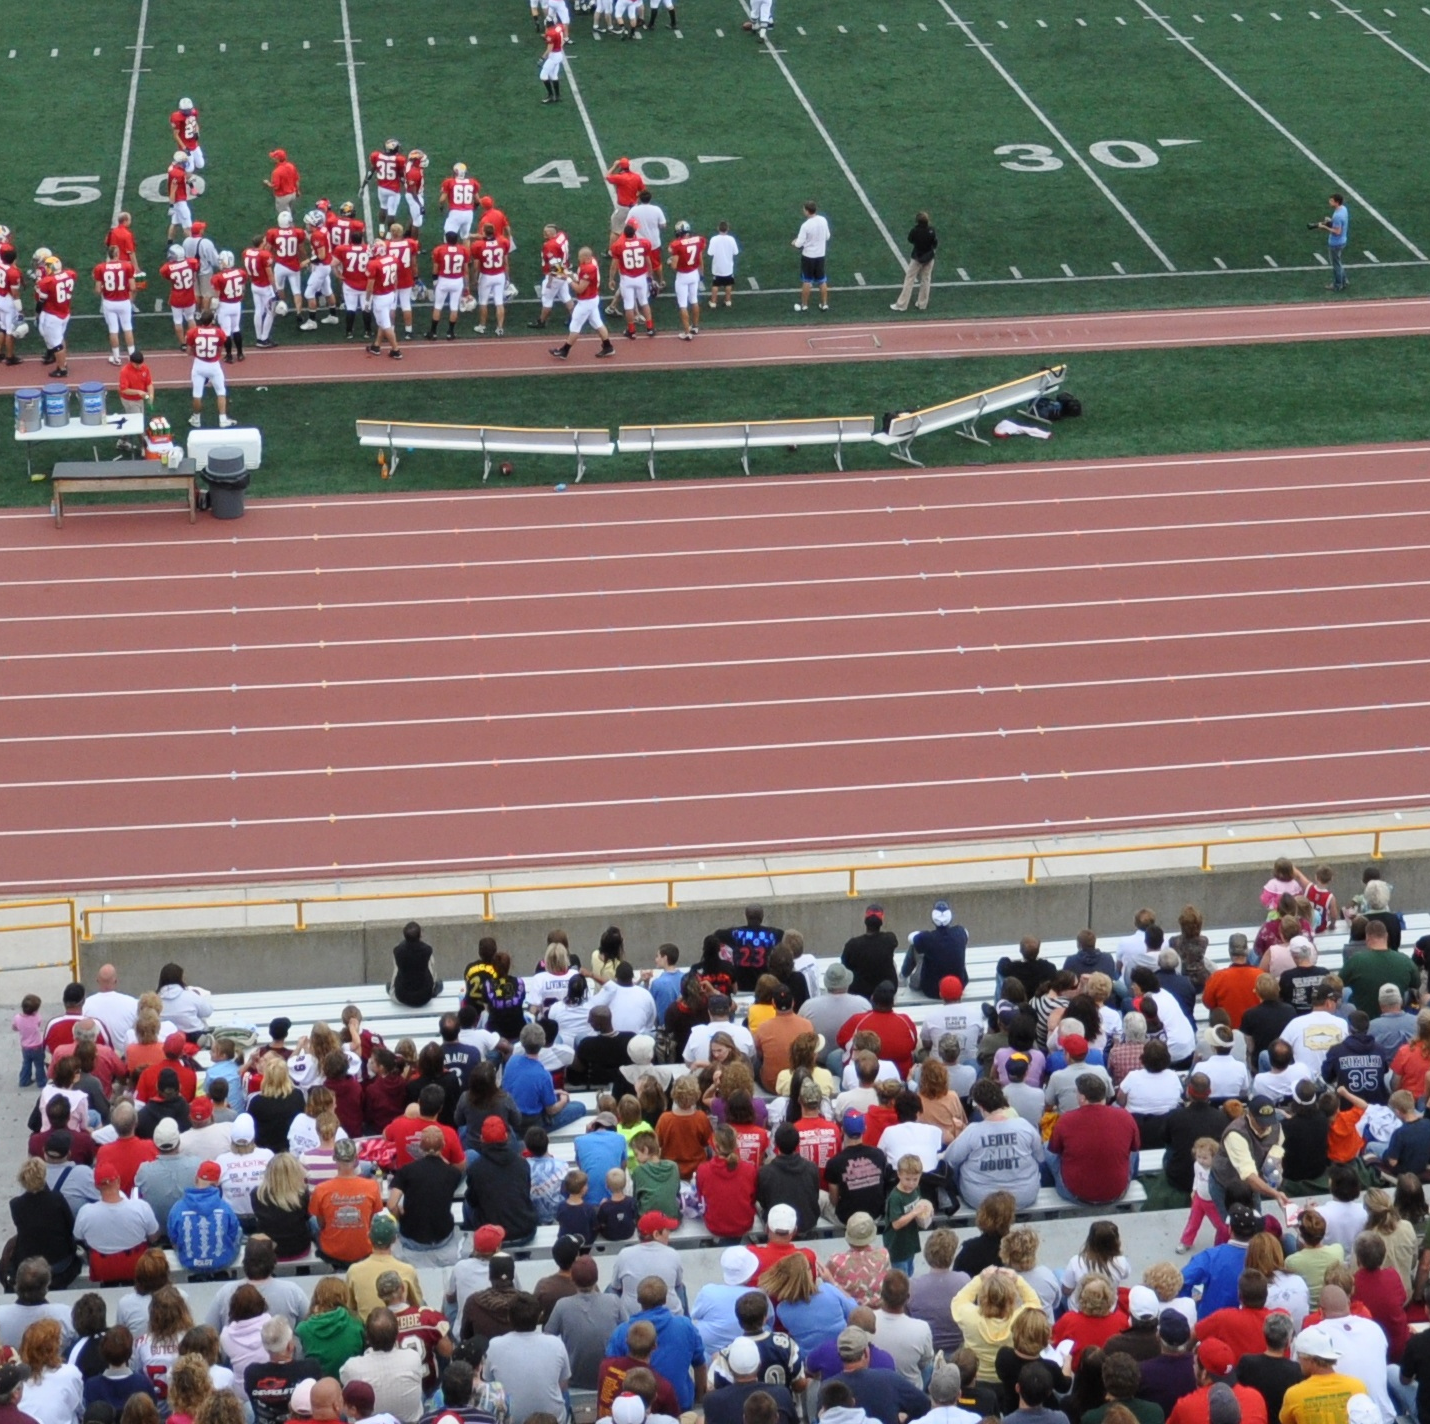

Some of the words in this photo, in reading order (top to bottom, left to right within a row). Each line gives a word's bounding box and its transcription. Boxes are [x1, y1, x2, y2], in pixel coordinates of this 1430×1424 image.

[993, 139, 1160, 172] 30
[376, 161, 397, 181] 35
[522, 155, 691, 189] 40
[33, 172, 206, 206] 50
[452, 184, 474, 205] 66
[275, 237, 298, 257] 30
[331, 226, 351, 246] 61
[345, 252, 368, 273] 78
[443, 255, 464, 275] 12
[482, 248, 504, 269] 33
[622, 247, 645, 270] 65
[686, 244, 698, 266] 7
[243, 257, 258, 276] 11
[382, 264, 398, 287] 72
[103, 270, 126, 292] 81
[170, 268, 193, 290] 32
[223, 276, 245, 299] 45
[194, 336, 220, 358] 25
[739, 946, 767, 969] 23
[1347, 1068, 1379, 1092] 35
[980, 1133, 1018, 1149] LEAVE
[979, 1156, 1020, 1172] DOUBT
